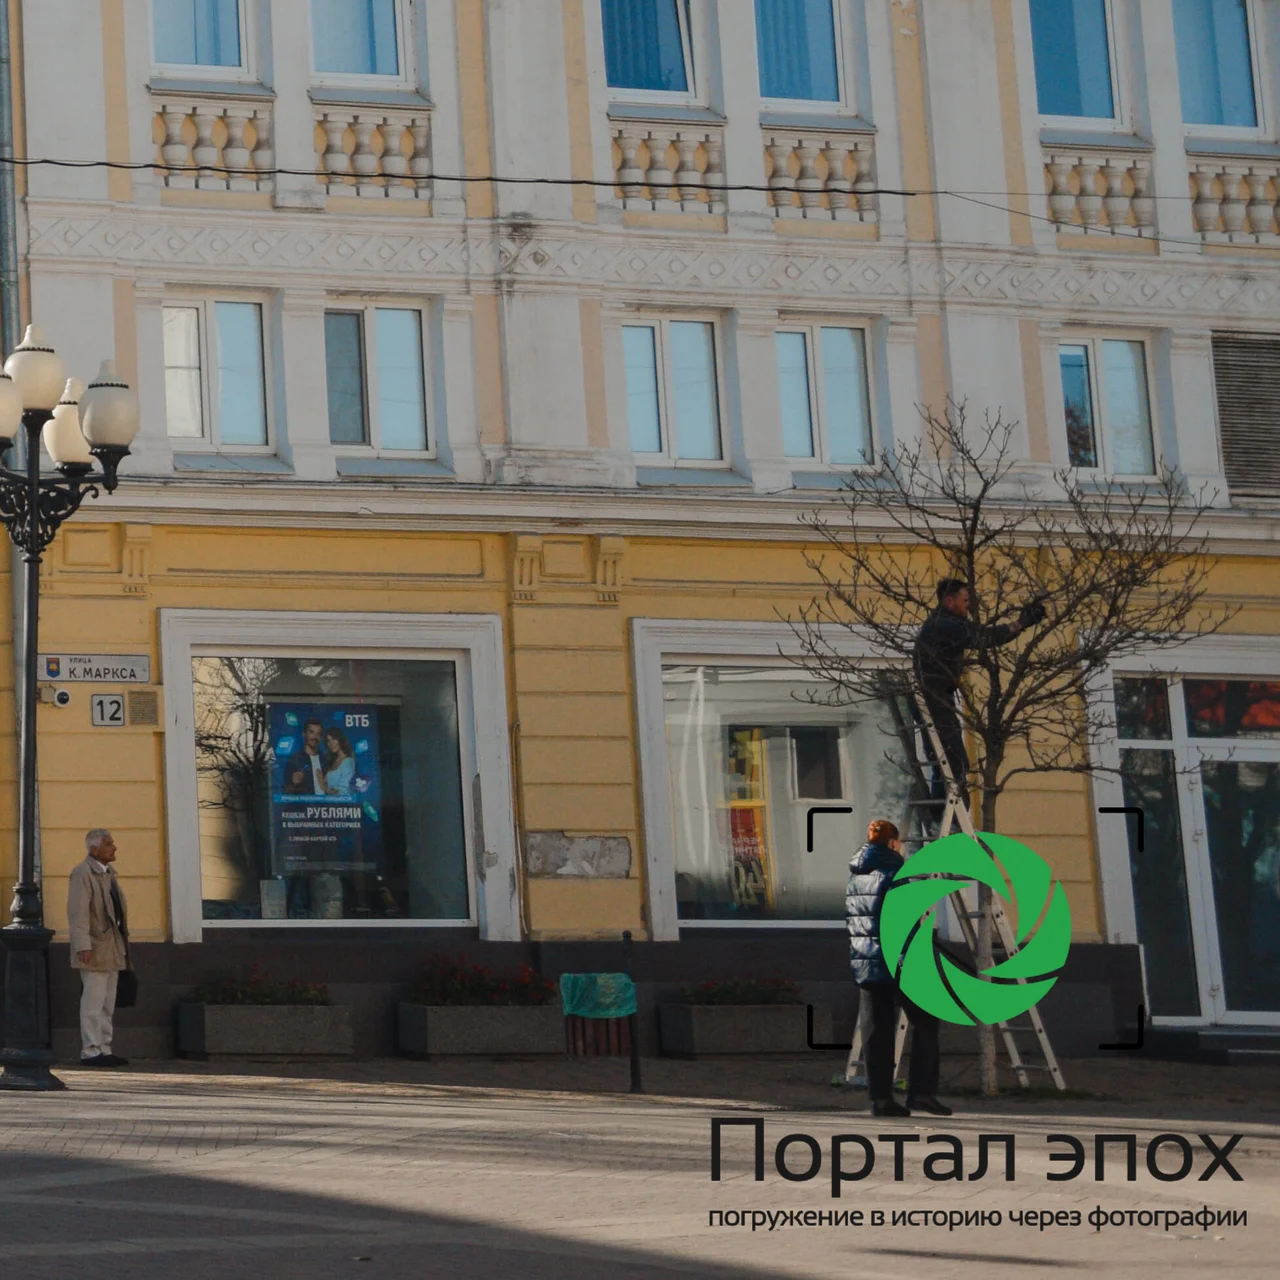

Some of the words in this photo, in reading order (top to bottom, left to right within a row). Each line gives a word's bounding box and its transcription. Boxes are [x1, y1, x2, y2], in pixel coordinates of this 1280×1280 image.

[96, 700, 122, 722] 12
[345, 714, 370, 727] ВТБ
[306, 807, 362, 819] РУБЛЯМИ
